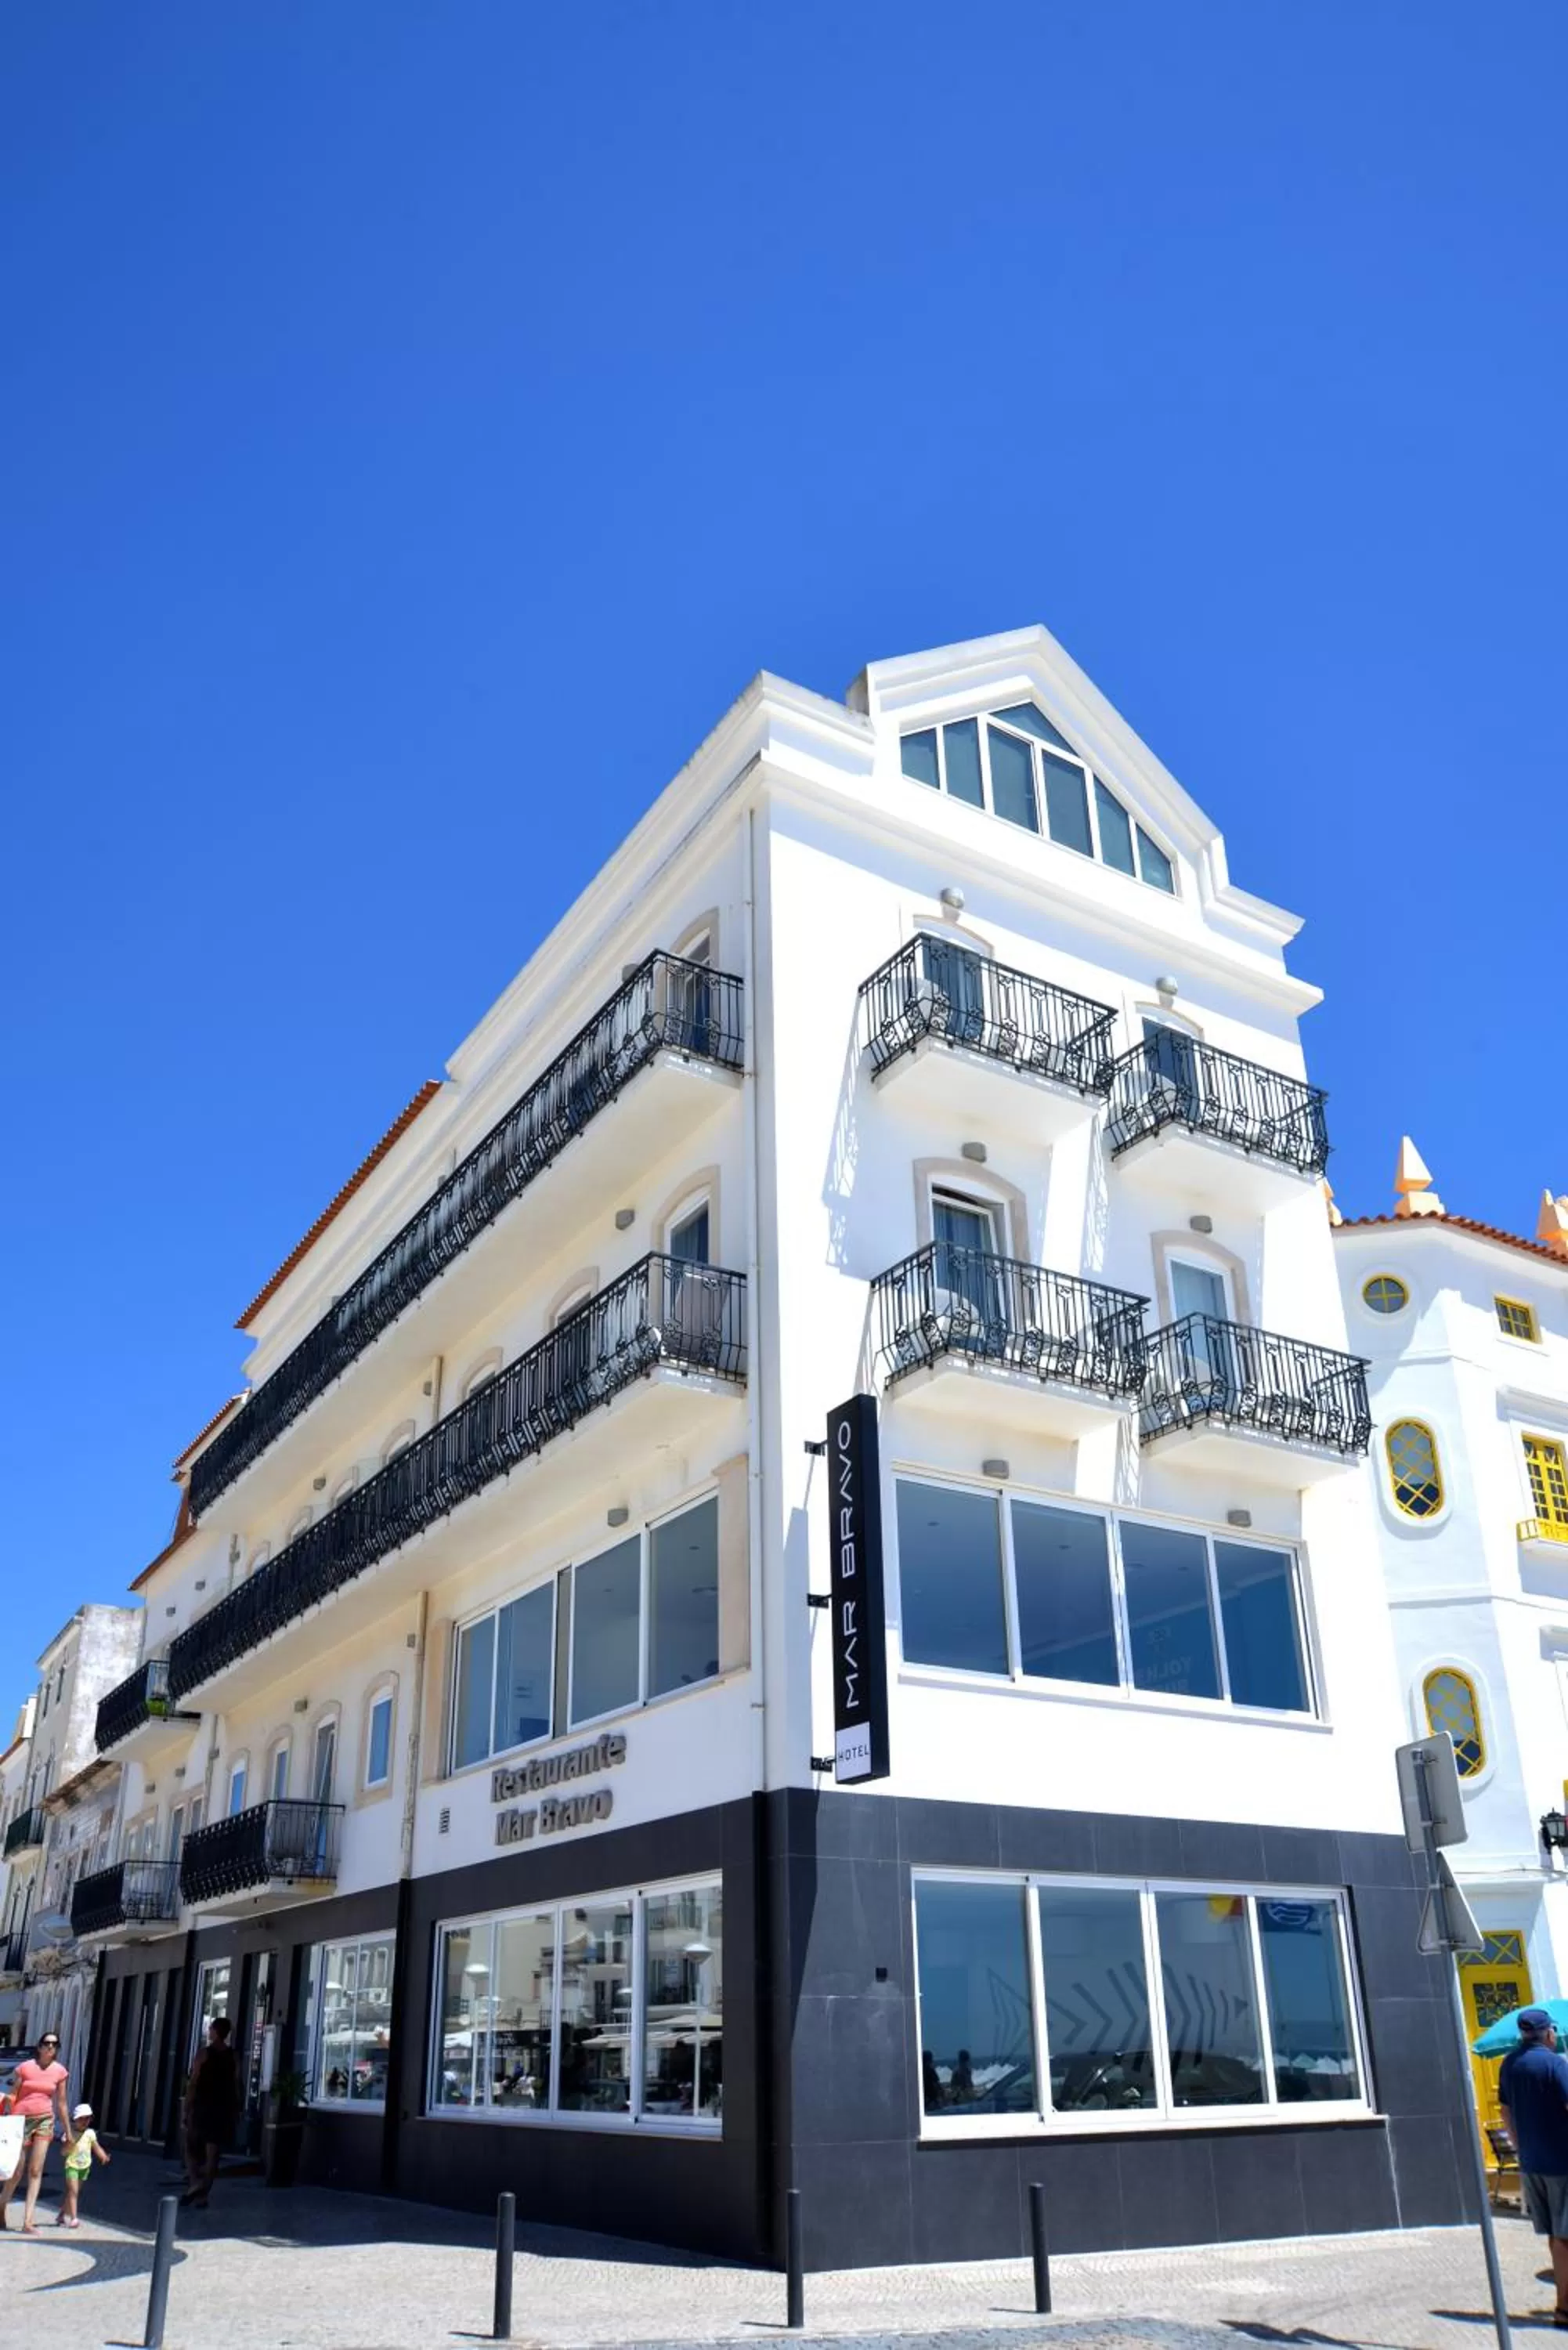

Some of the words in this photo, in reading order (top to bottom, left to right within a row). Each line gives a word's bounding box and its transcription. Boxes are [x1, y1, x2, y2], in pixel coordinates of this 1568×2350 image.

[837, 1421, 855, 1578] BRAVO
[844, 1600, 859, 1708] MAR
[491, 1734, 627, 1802] Restaurante
[838, 1744, 871, 1761] HOTEL
[496, 1808, 537, 1846] Mar
[540, 1788, 613, 1834] Bravo
